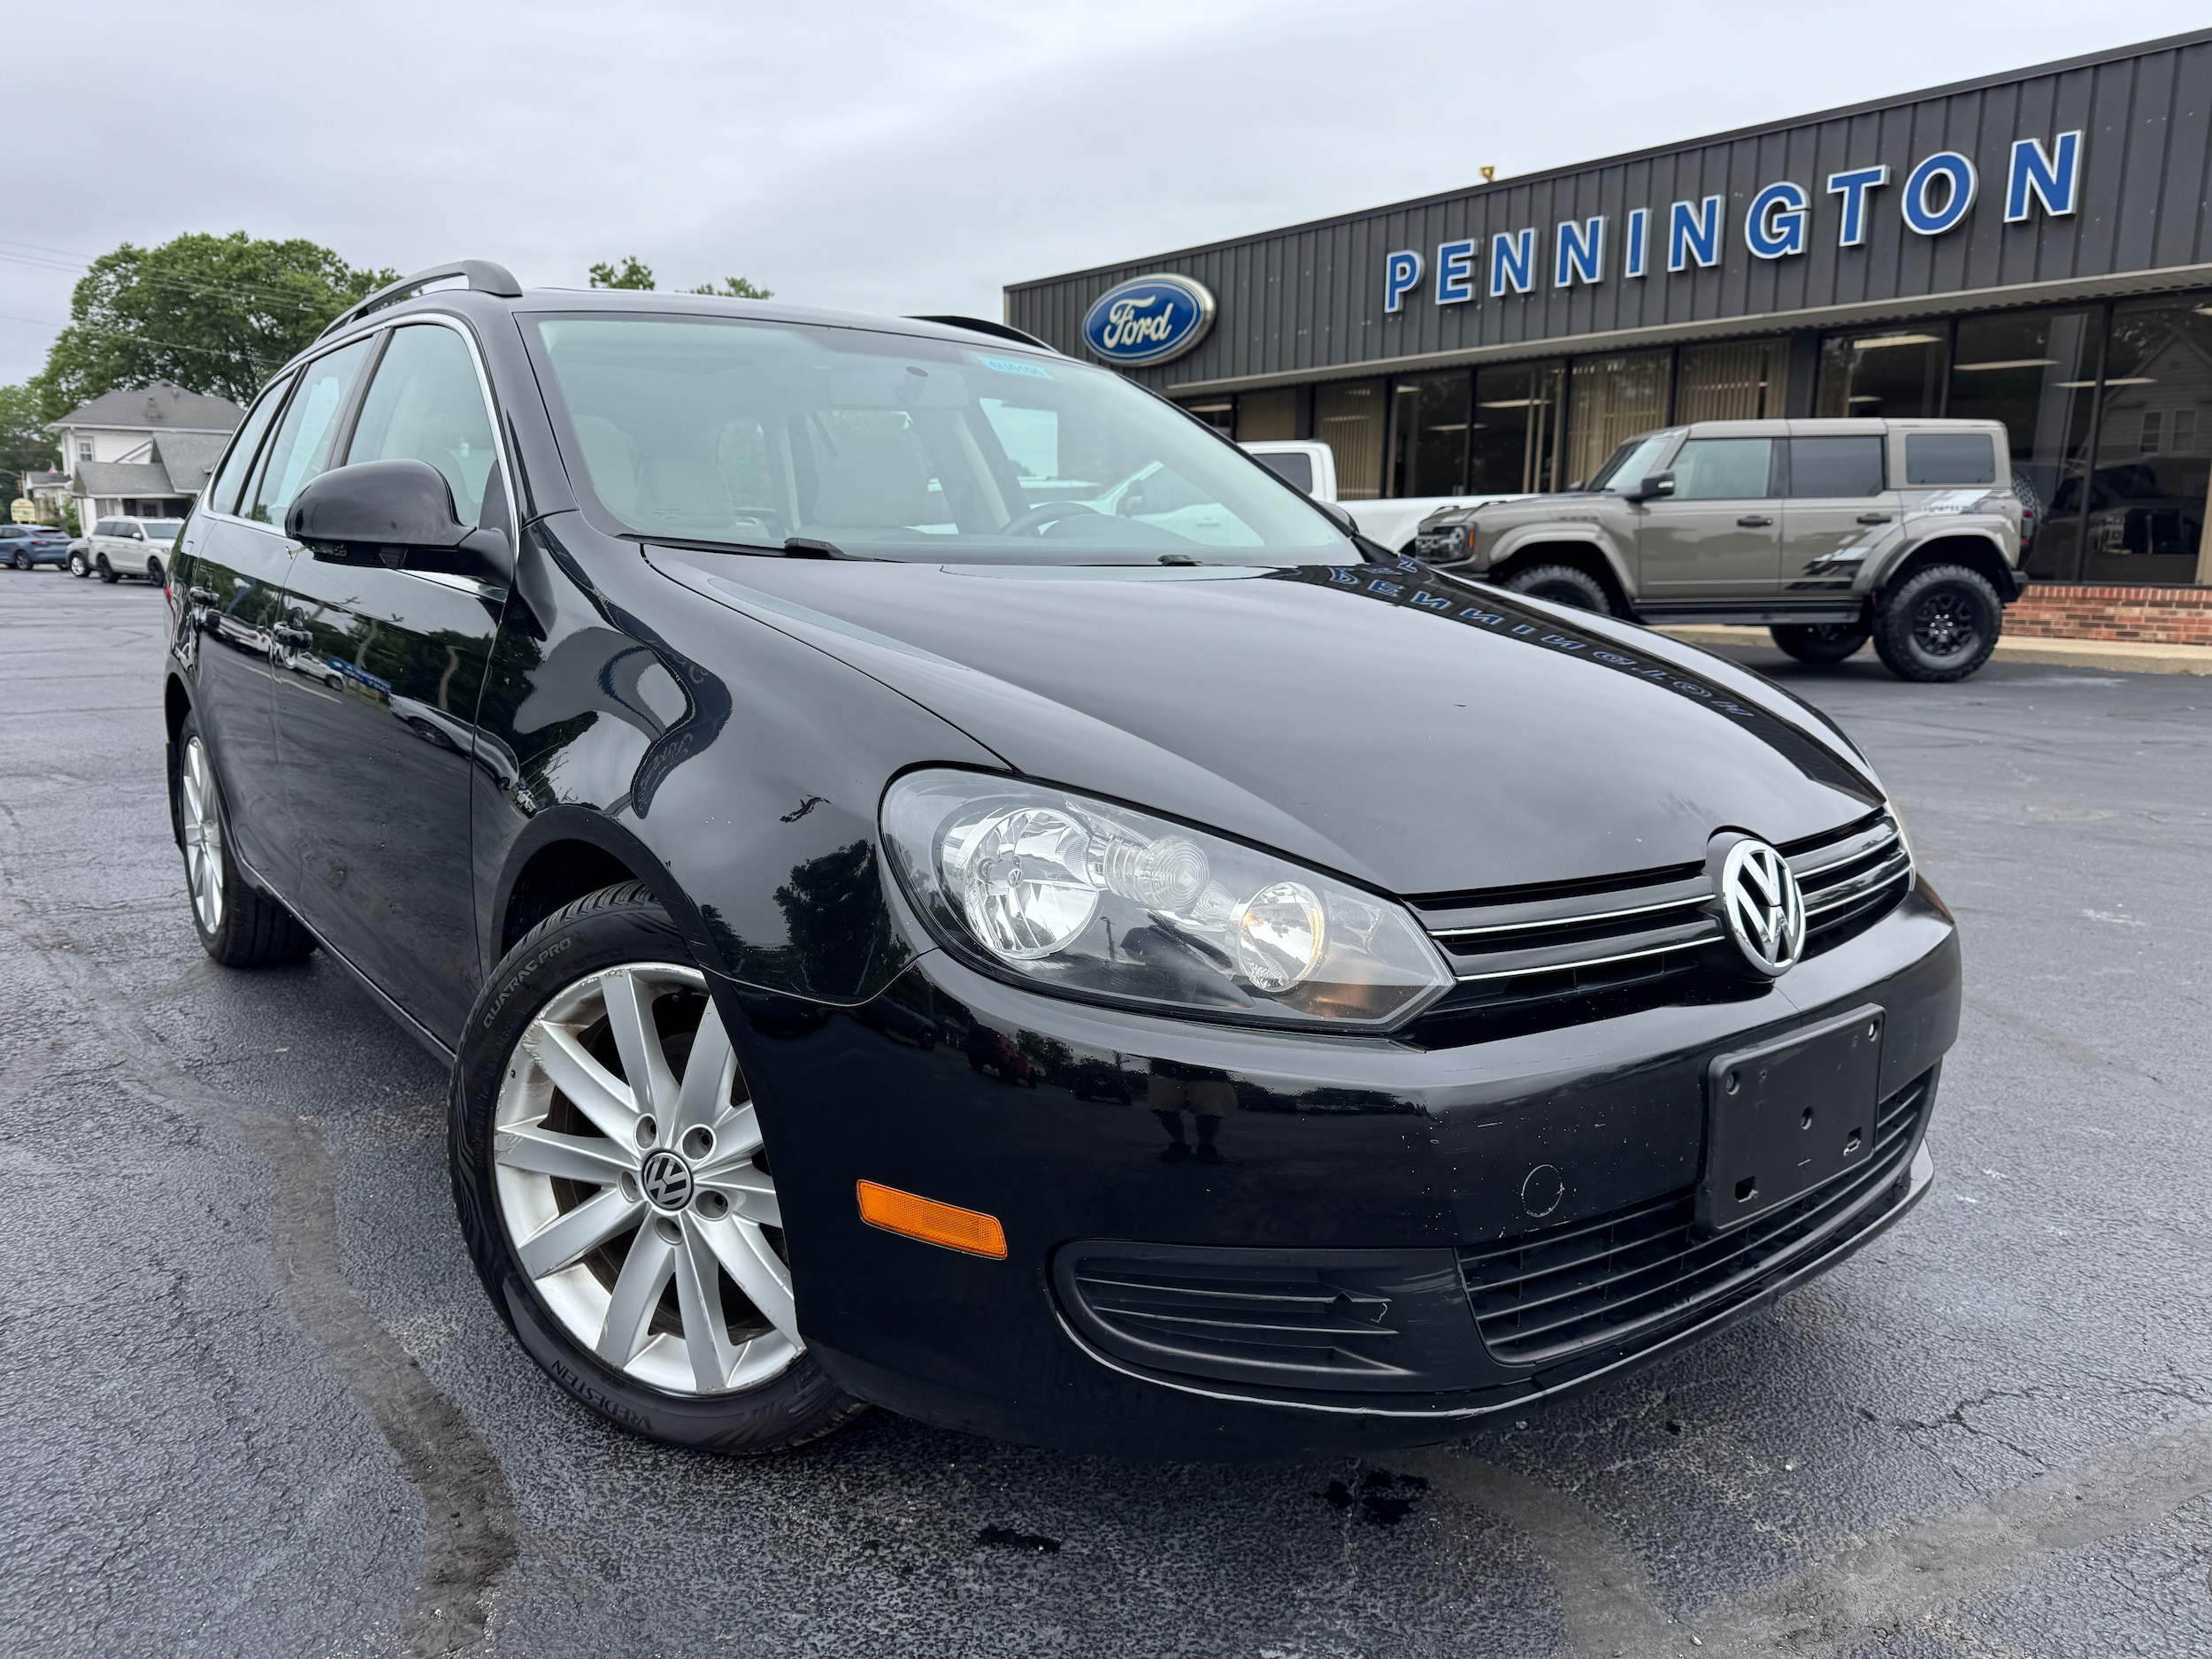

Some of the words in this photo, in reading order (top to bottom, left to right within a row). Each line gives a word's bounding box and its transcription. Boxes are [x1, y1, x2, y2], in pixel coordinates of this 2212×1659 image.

[1384, 129, 2085, 313] PENNINGTON
[1102, 294, 1174, 349] Ford
[483, 960, 538, 1028] QUATRAC
[537, 936, 573, 964] PRO
[550, 1359, 654, 1432] VREDESTEIN
